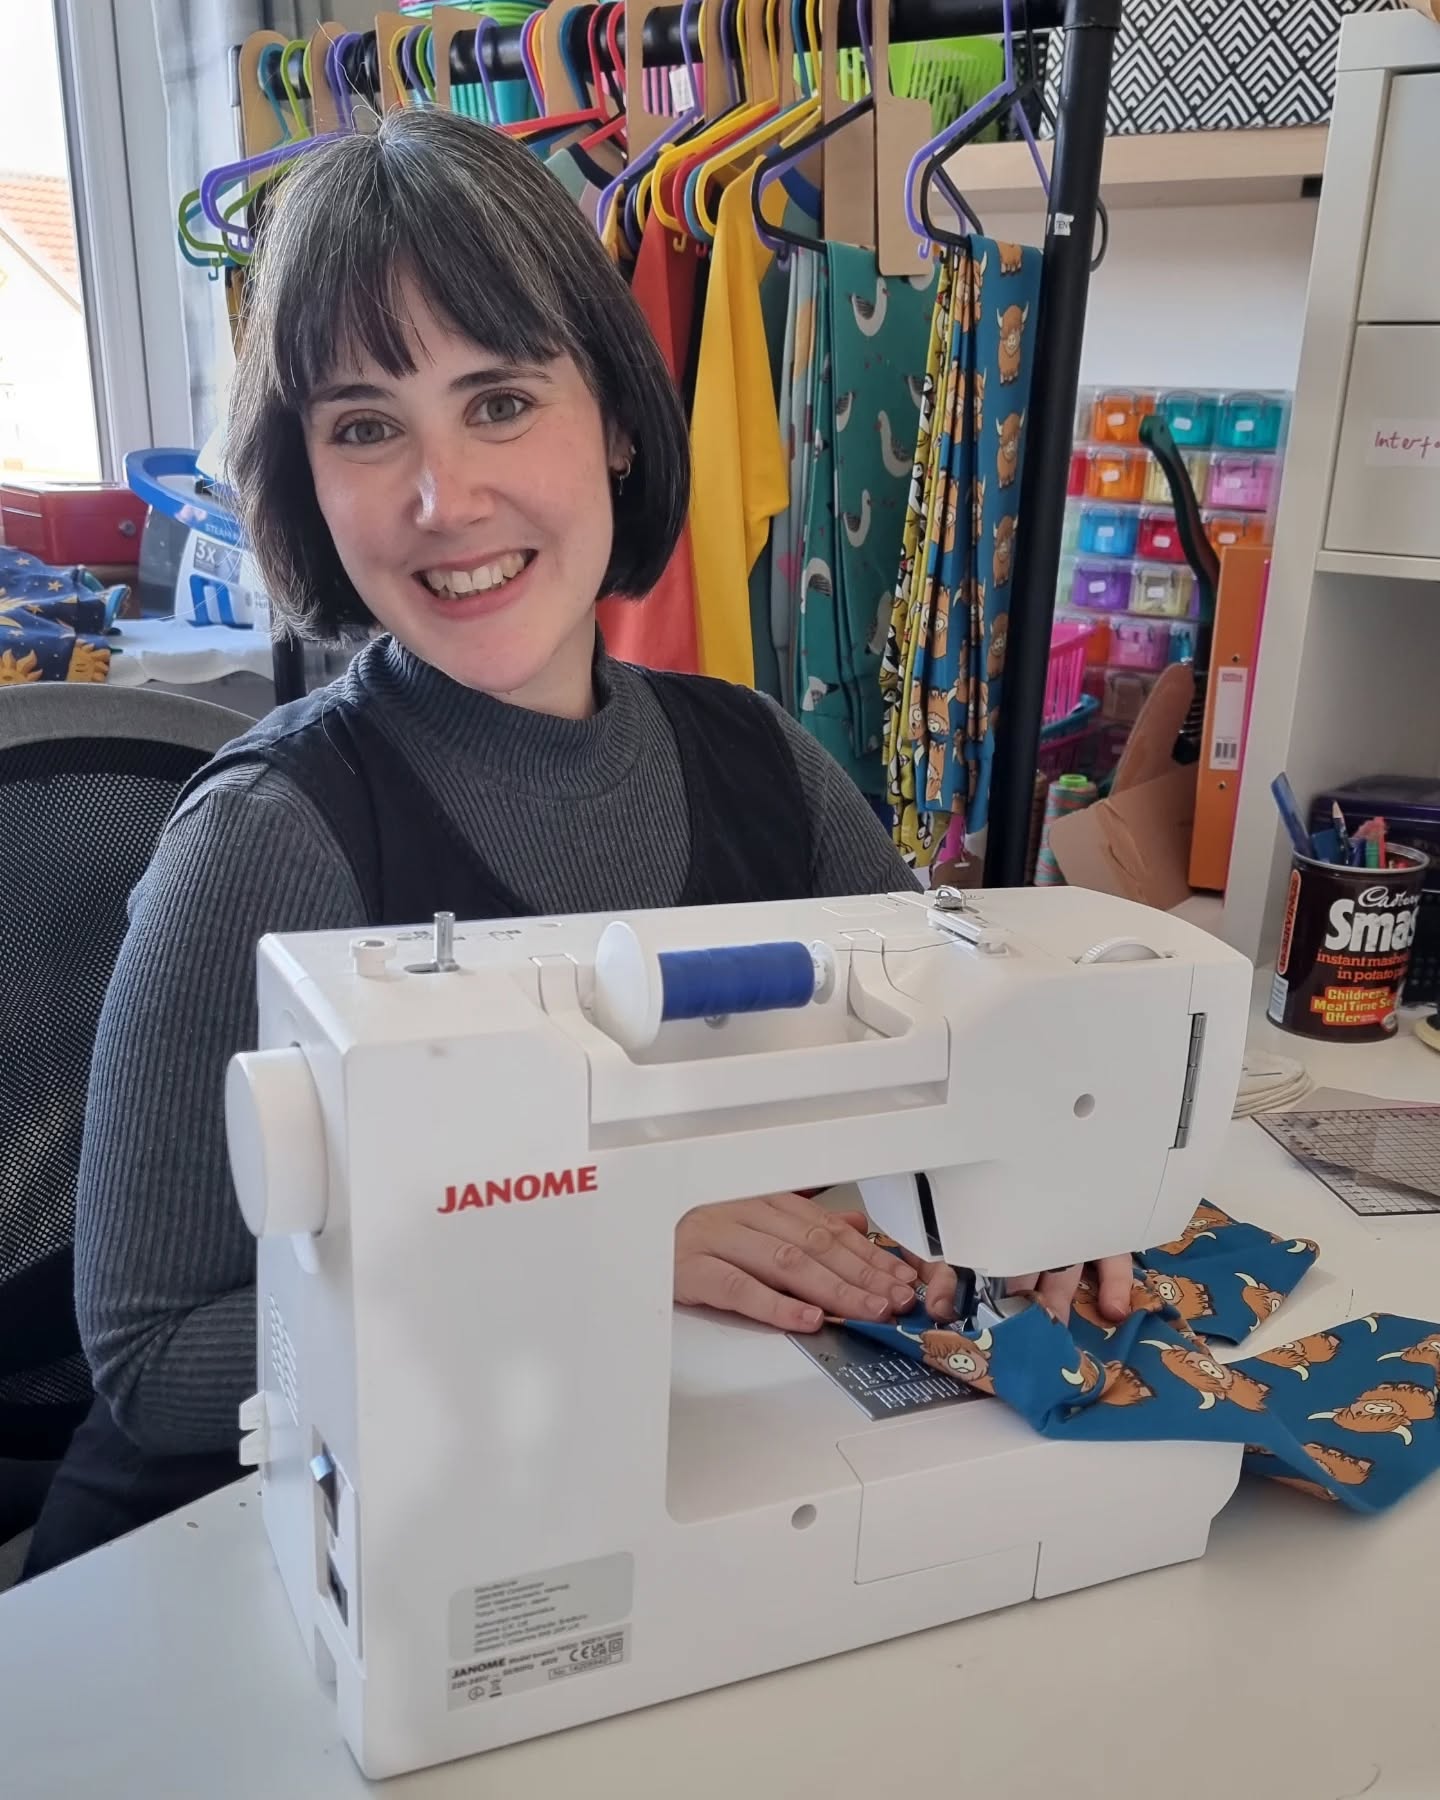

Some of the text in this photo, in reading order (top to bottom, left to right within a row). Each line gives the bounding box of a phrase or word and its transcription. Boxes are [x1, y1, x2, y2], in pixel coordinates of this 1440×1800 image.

[1317, 949, 1365, 967] instant
[1337, 966, 1352, 980] in
[1353, 968, 1393, 983] potato
[1314, 999, 1347, 1011] Meal
[1349, 1001, 1377, 1011] Time
[1325, 1011, 1361, 1023] Offer
[437, 1165, 598, 1214] JANOME
[451, 1657, 506, 1679] JANOME
